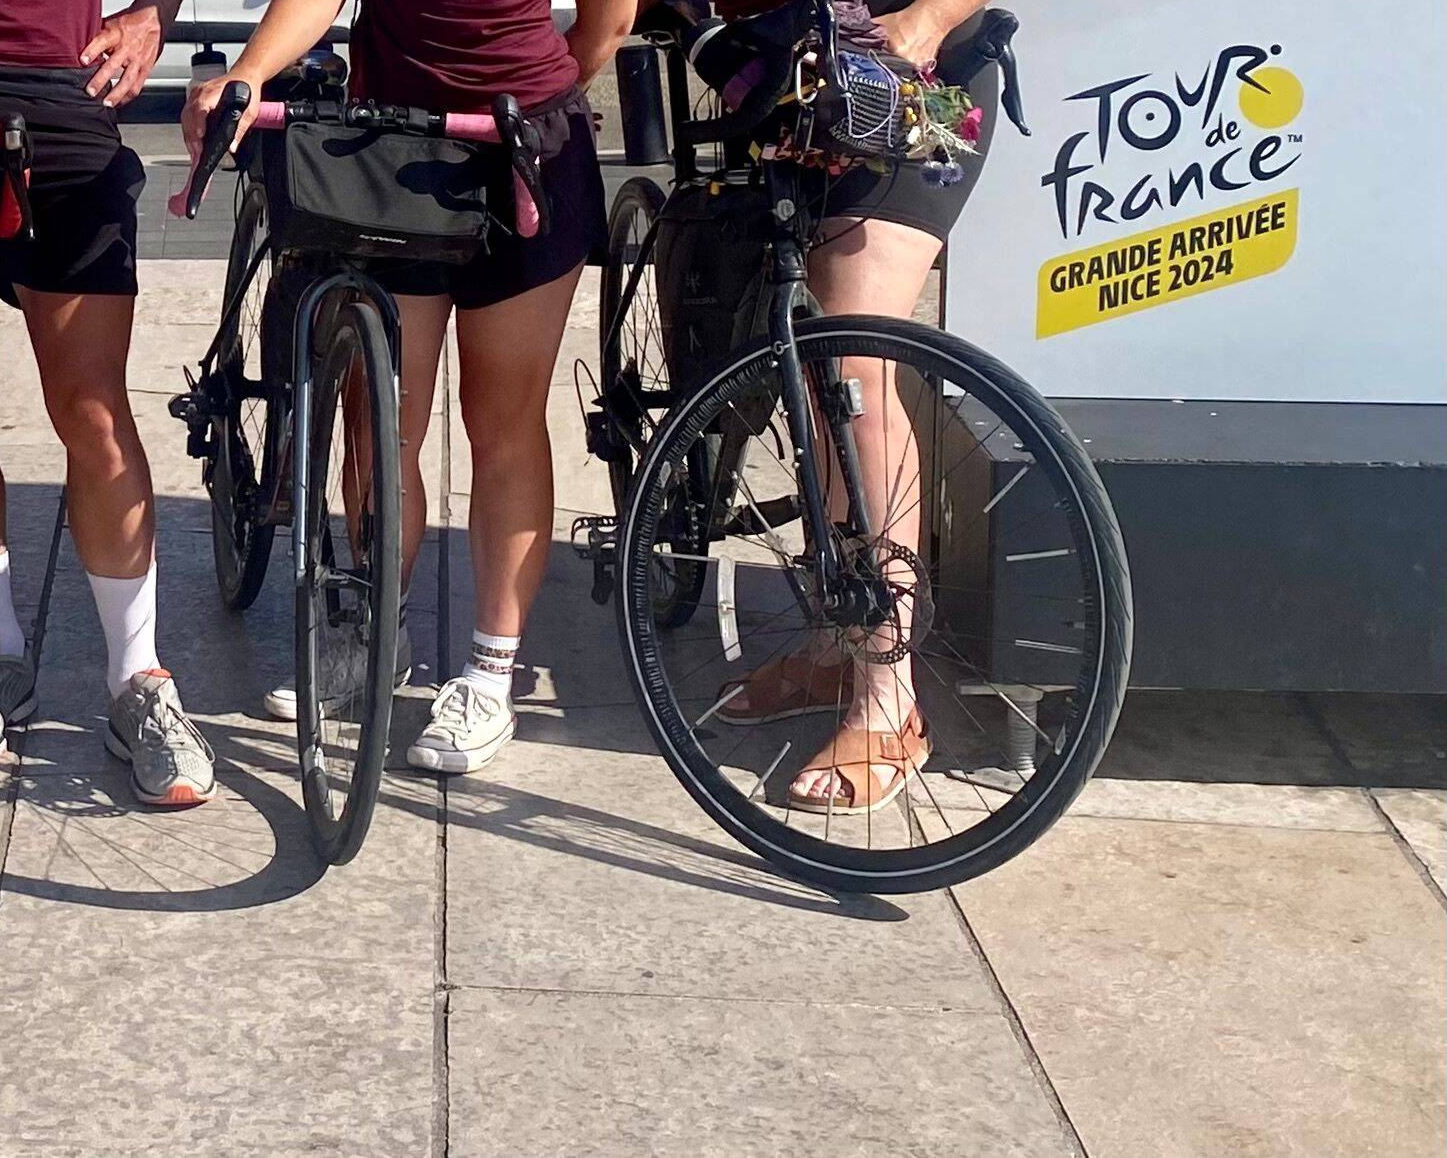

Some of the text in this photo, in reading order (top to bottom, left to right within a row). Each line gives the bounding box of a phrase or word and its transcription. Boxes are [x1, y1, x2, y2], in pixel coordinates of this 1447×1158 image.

[1061, 43, 1283, 165] TOUR
[1205, 112, 1242, 148] de
[1049, 201, 1287, 293] GRANDE ARRIVÉE
[1098, 248, 1234, 312] NICE 2024
